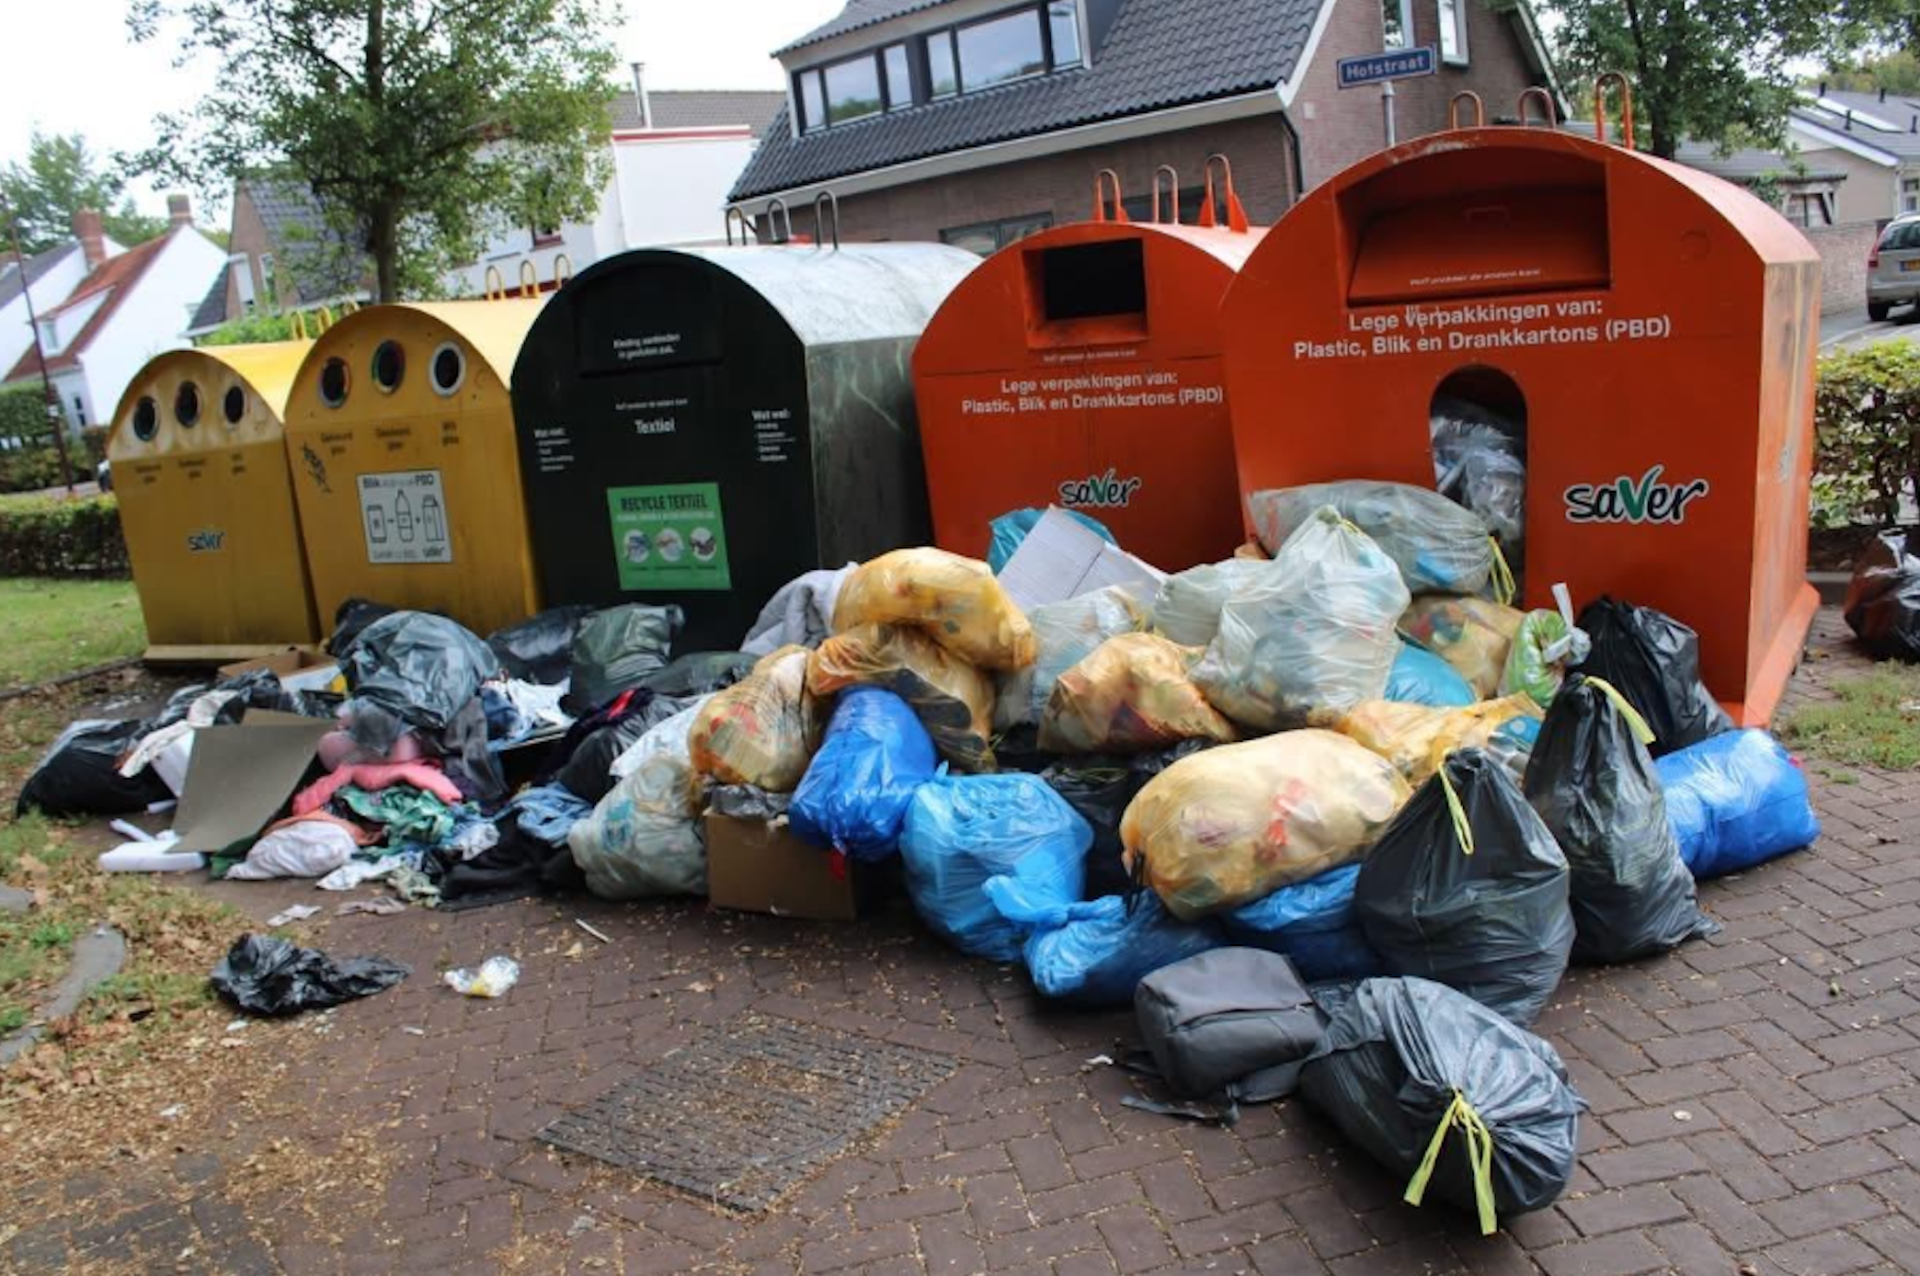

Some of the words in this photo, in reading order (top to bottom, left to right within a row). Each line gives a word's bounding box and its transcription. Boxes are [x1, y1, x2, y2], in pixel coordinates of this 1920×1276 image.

[1346, 56, 1426, 79] Hofstraat
[1350, 313, 1399, 333] Lege
[1556, 300, 1603, 317] van:
[1294, 341, 1367, 359] Plastic,
[1372, 336, 1411, 354] Blik
[1417, 336, 1442, 351] en
[1449, 325, 1599, 349] Drankkartons
[1605, 315, 1671, 342] (PBD)
[1001, 379, 1037, 395] Lege
[1040, 374, 1142, 392] verpakkingen
[1145, 372, 1179, 384] van:
[962, 398, 1015, 414] Plastic,
[1019, 396, 1047, 411] Blik
[1050, 399, 1069, 410] en
[1072, 391, 1177, 409] Drankkartons
[1179, 386, 1223, 406] (PBD)
[635, 417, 675, 434] Textiel
[620, 496, 666, 512] RECYCLE
[667, 494, 708, 509] TEXTIEL
